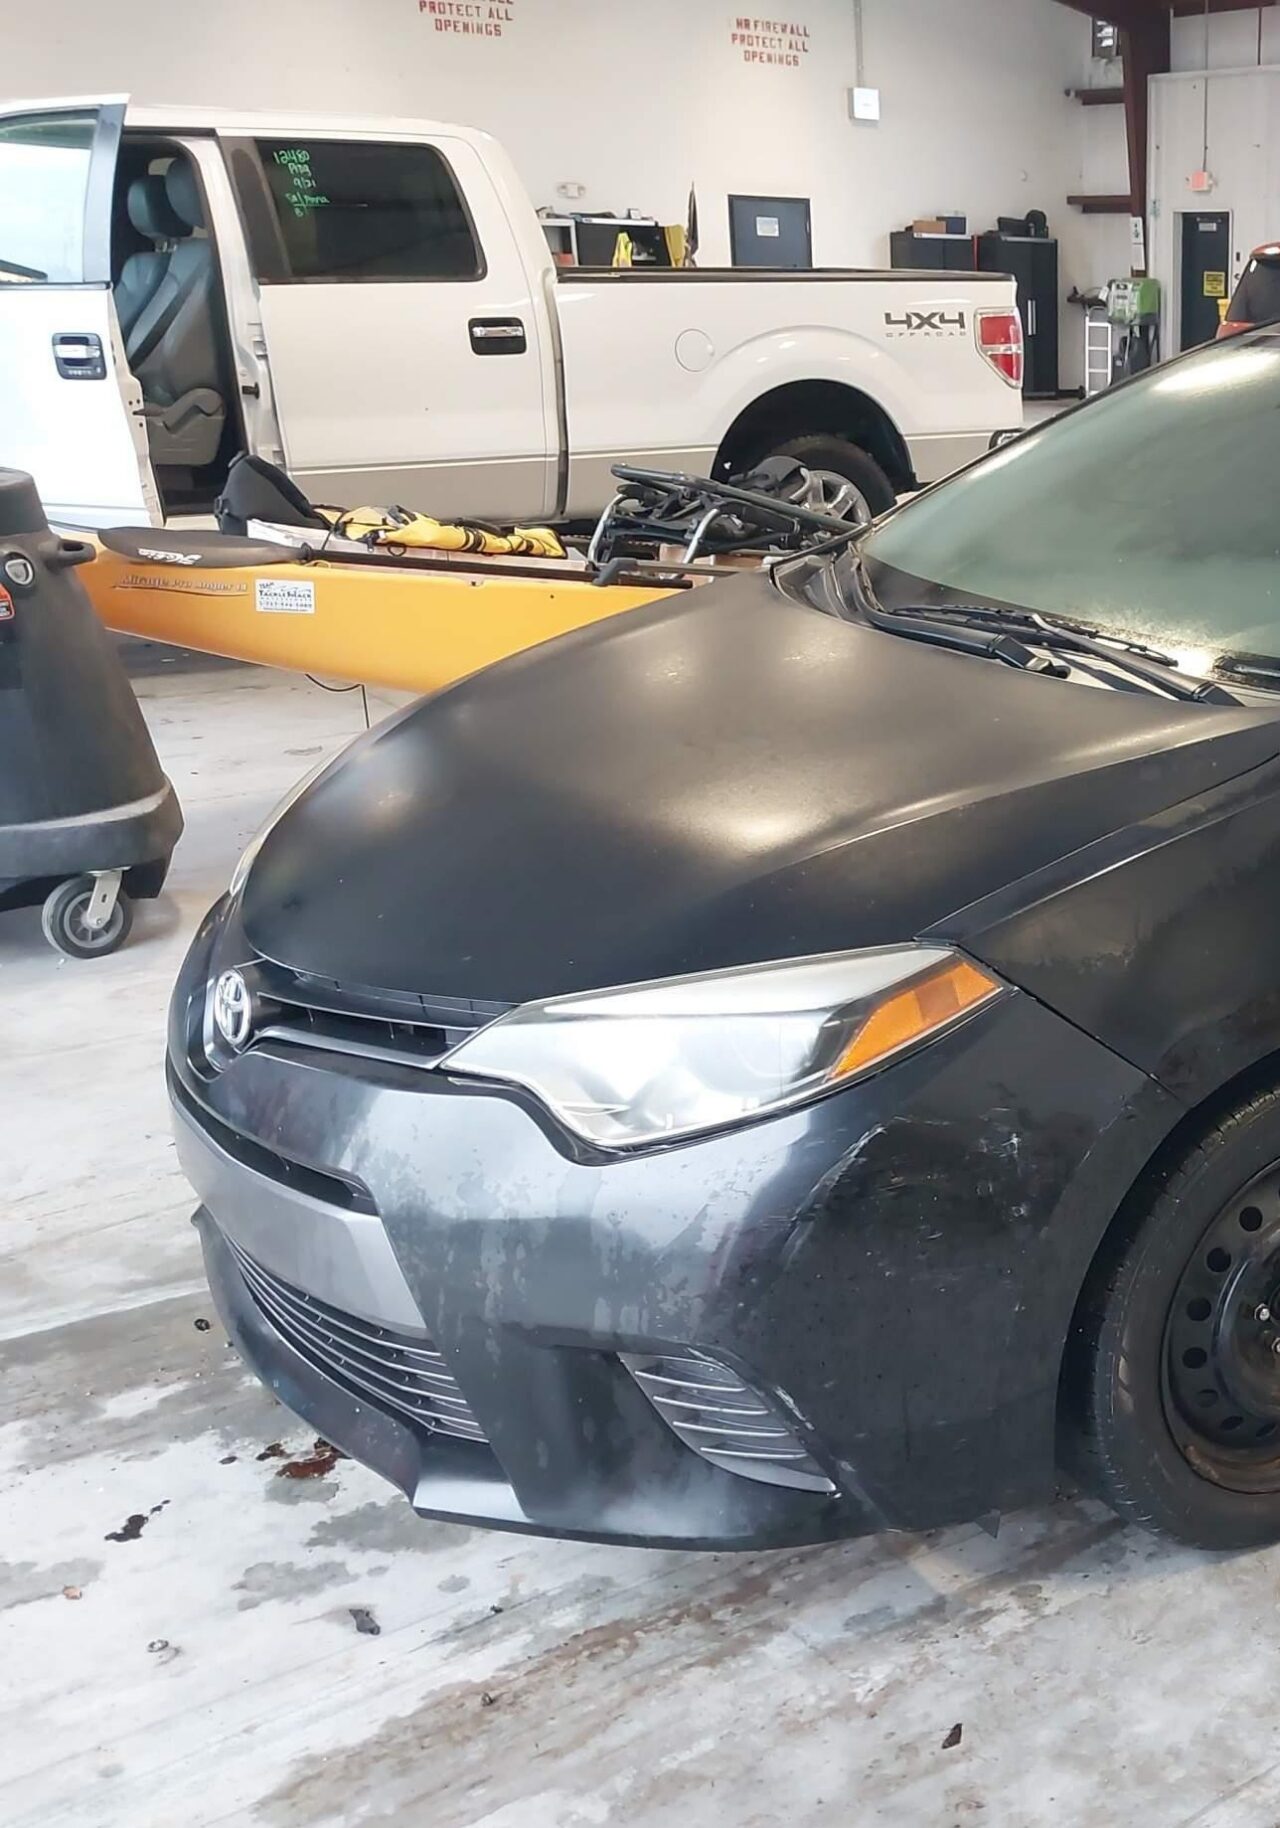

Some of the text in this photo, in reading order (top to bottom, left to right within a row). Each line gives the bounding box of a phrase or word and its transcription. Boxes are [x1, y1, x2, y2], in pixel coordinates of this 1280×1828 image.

[419, 1, 514, 21] PROTECT ALL
[434, 18, 502, 36] OPENINGS
[753, 20, 810, 37] FIREWALL
[731, 33, 809, 52] PROTECT ALL
[743, 50, 799, 66] OPENINGS
